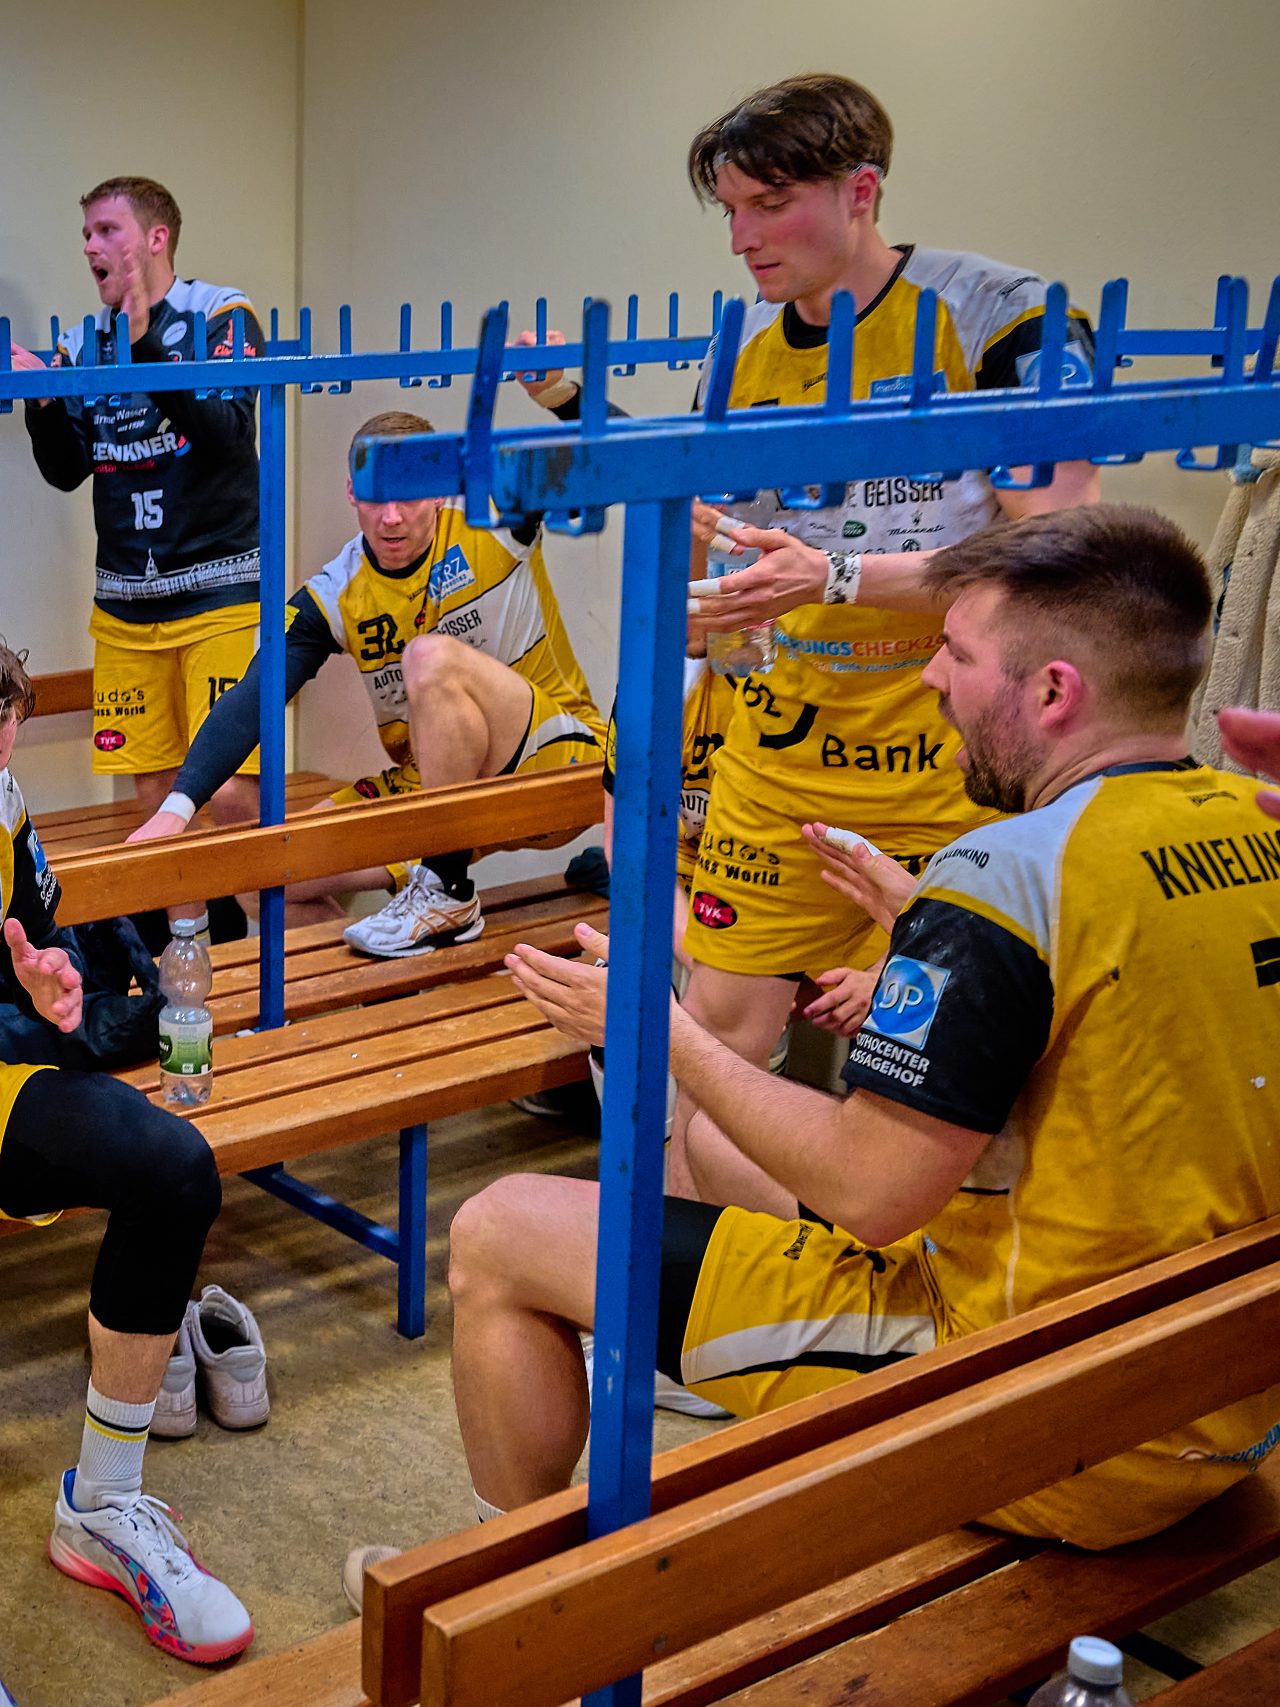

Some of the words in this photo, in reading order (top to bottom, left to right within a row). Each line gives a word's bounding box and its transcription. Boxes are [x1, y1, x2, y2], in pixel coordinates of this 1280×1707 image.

[131, 489, 164, 530] 15
[864, 478, 943, 508] GEISSER
[357, 612, 406, 661] 32
[115, 704, 146, 716] World
[821, 733, 946, 773] Bank
[725, 863, 780, 886] World
[1139, 829, 1280, 901] KNIELIN
